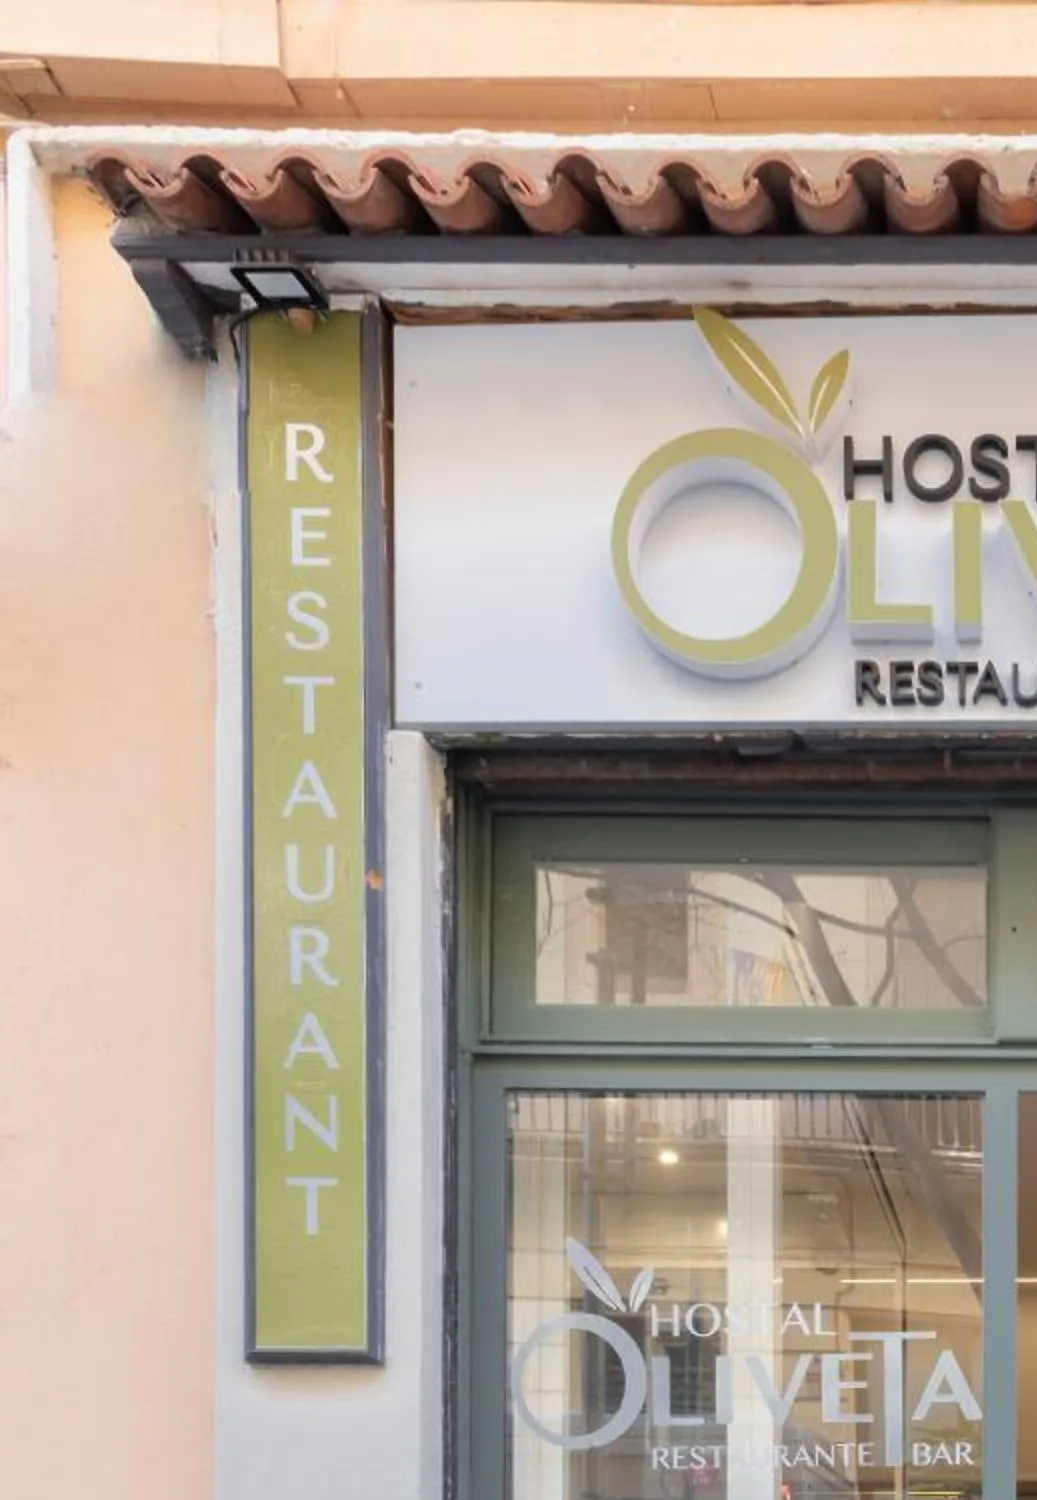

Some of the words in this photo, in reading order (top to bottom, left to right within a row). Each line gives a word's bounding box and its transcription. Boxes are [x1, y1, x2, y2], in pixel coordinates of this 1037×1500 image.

[282, 422, 337, 1236] RESTAURANT
[651, 1302, 836, 1337] HOSTAL
[511, 1312, 984, 1467] OLIVETA
[652, 1442, 874, 1470] RESTRANTE
[912, 1442, 975, 1467] BAR
